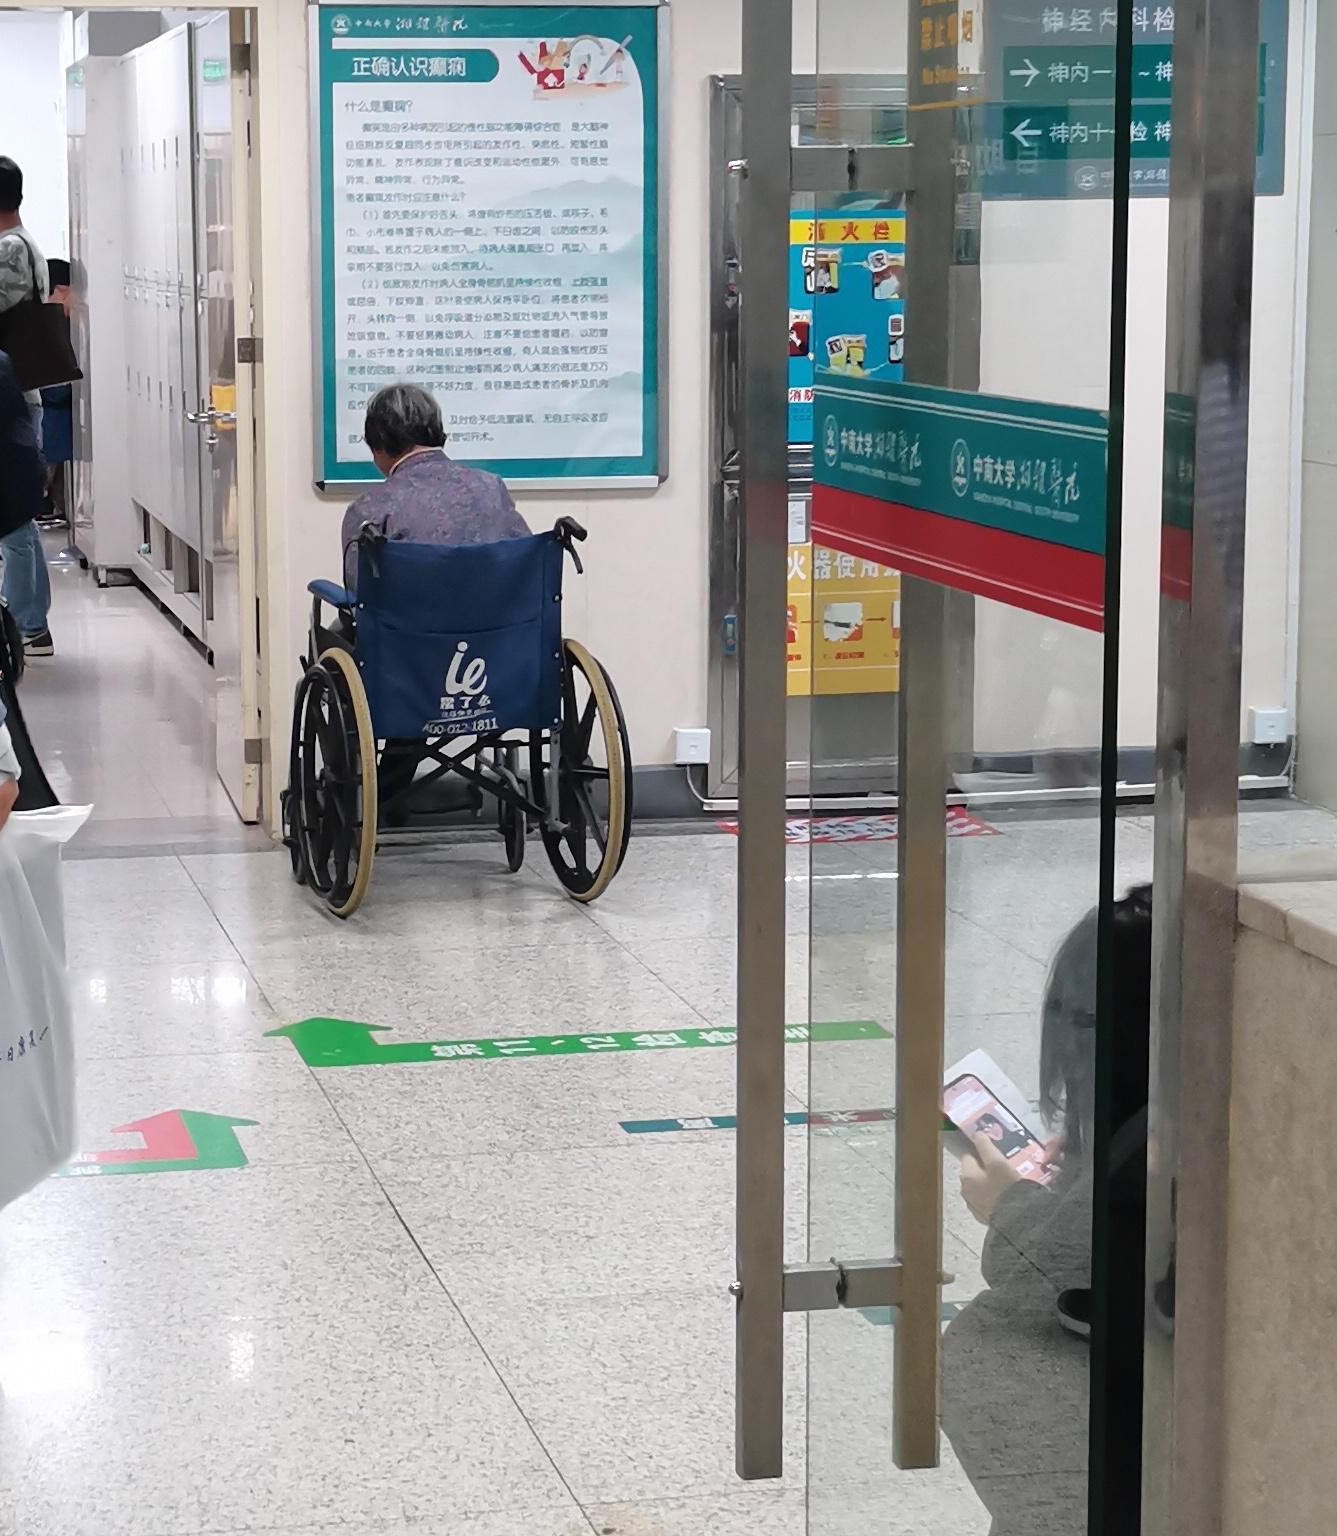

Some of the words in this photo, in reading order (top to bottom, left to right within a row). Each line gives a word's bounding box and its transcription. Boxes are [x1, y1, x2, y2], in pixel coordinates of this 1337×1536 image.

[351, 55, 467, 78] 正确认识癫痫
